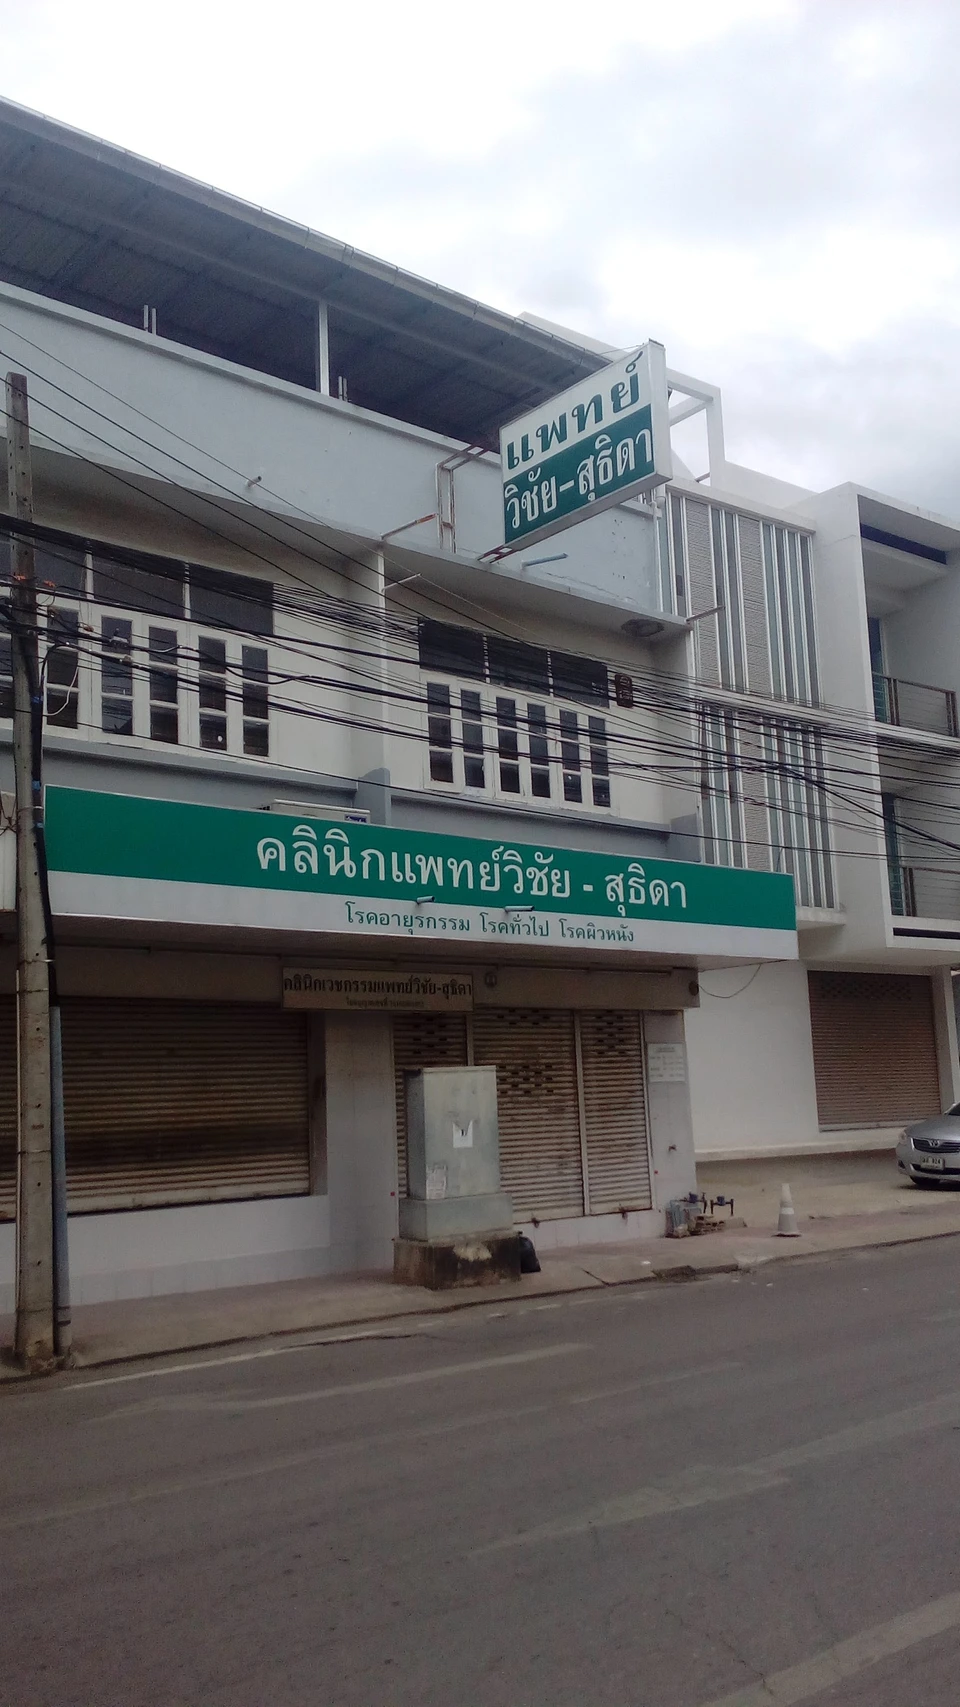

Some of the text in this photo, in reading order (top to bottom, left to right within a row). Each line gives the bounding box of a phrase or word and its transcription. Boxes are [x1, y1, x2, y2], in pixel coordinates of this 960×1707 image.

[506, 351, 644, 470] แพทย์
[504, 428, 653, 529] วิชัย-สุธิดา
[256, 824, 687, 917] คลินิกแพทย์วิชัย - สุธิดา
[345, 901, 634, 942] โรคอายุรกรรม โรคทั่วไป โรคผิวหนัง
